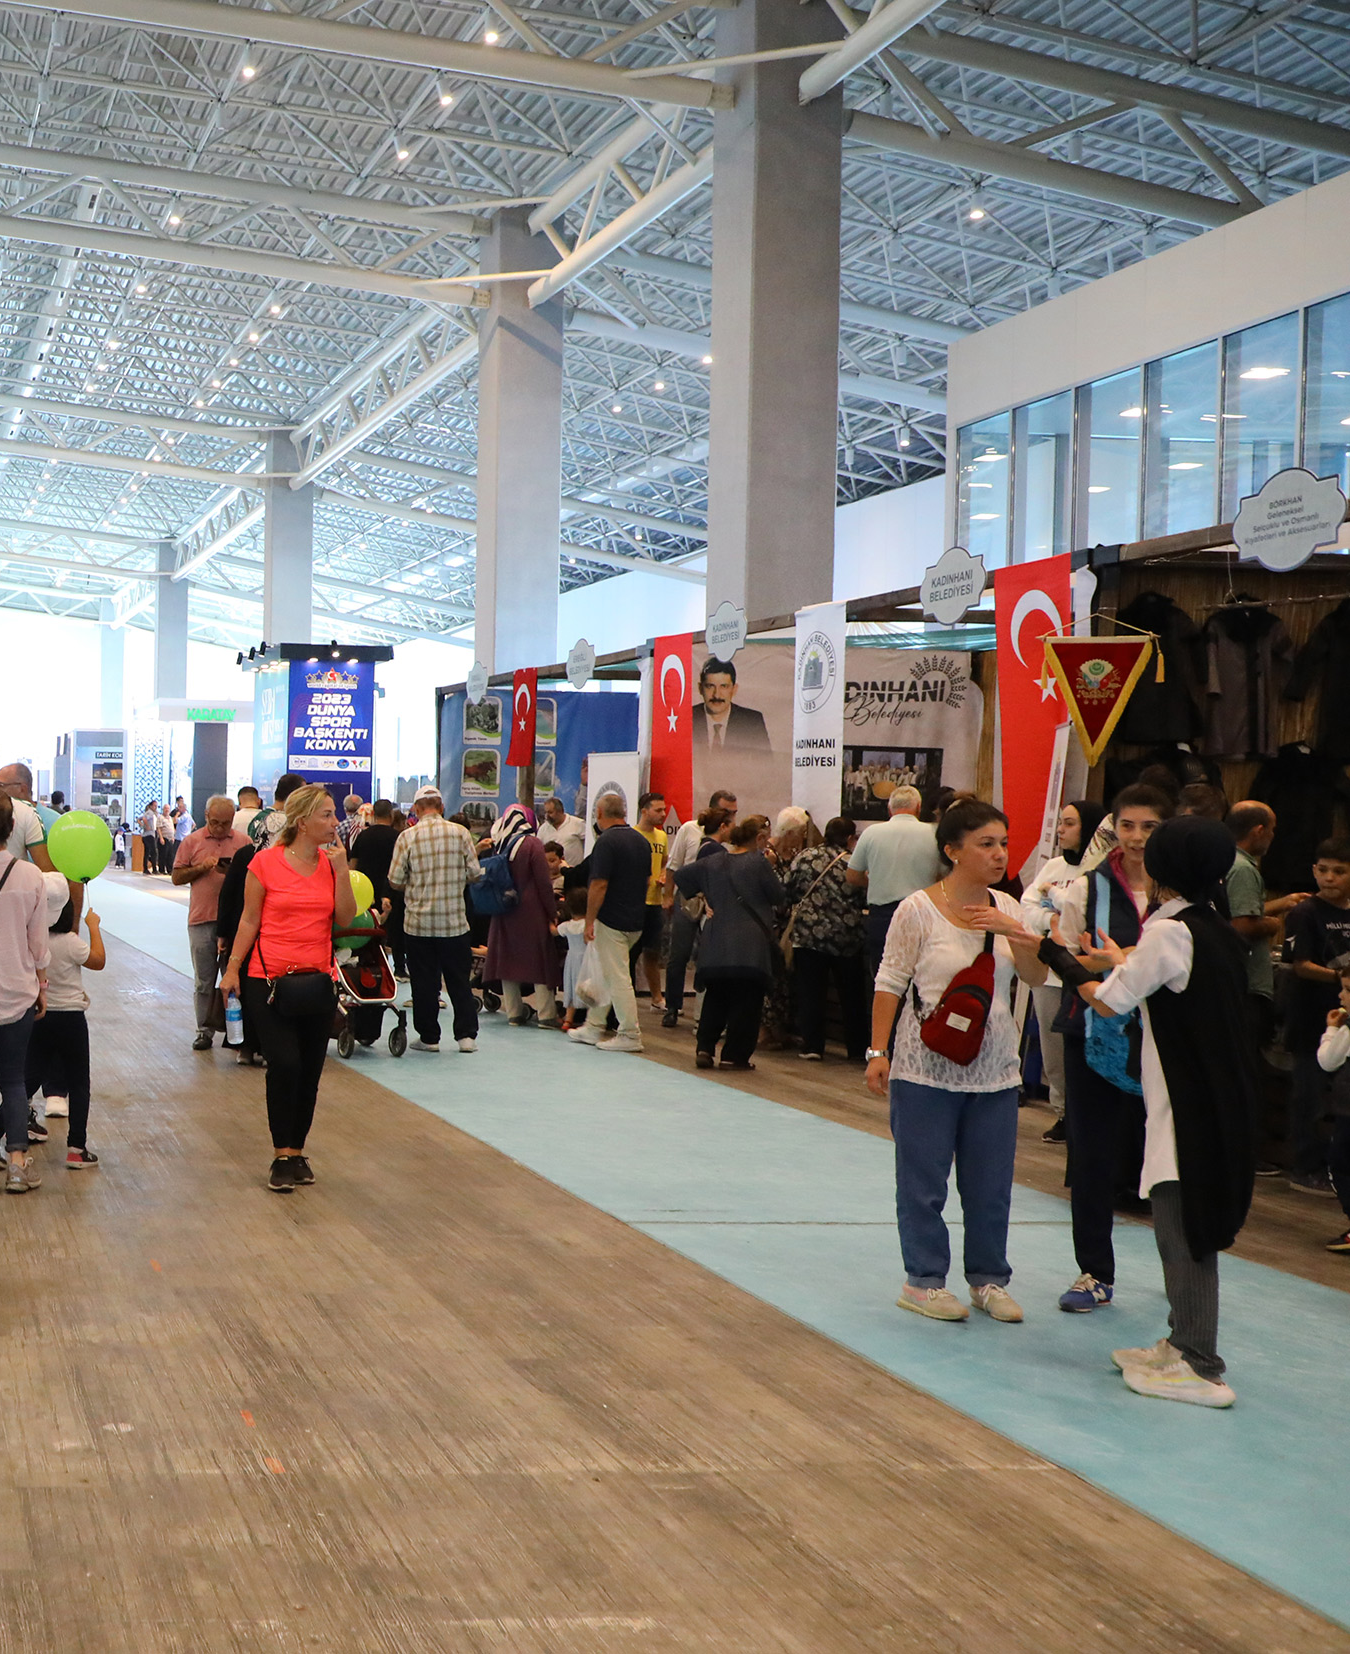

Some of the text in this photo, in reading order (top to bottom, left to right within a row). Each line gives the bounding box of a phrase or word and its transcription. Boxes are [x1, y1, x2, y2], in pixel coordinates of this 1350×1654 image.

[1266, 505, 1304, 520] Geleneksel
[931, 569, 974, 589] KADINHANI
[929, 581, 974, 603] BELEDİYESİ
[311, 693, 352, 705] 2023
[844, 680, 946, 704] DINHANI
[187, 707, 237, 722] KARATAY
[310, 716, 352, 728] SPOR
[304, 739, 356, 751] KONYA
[795, 738, 836, 750] KADINHANI
[794, 754, 836, 768] BELEDİYESİ
